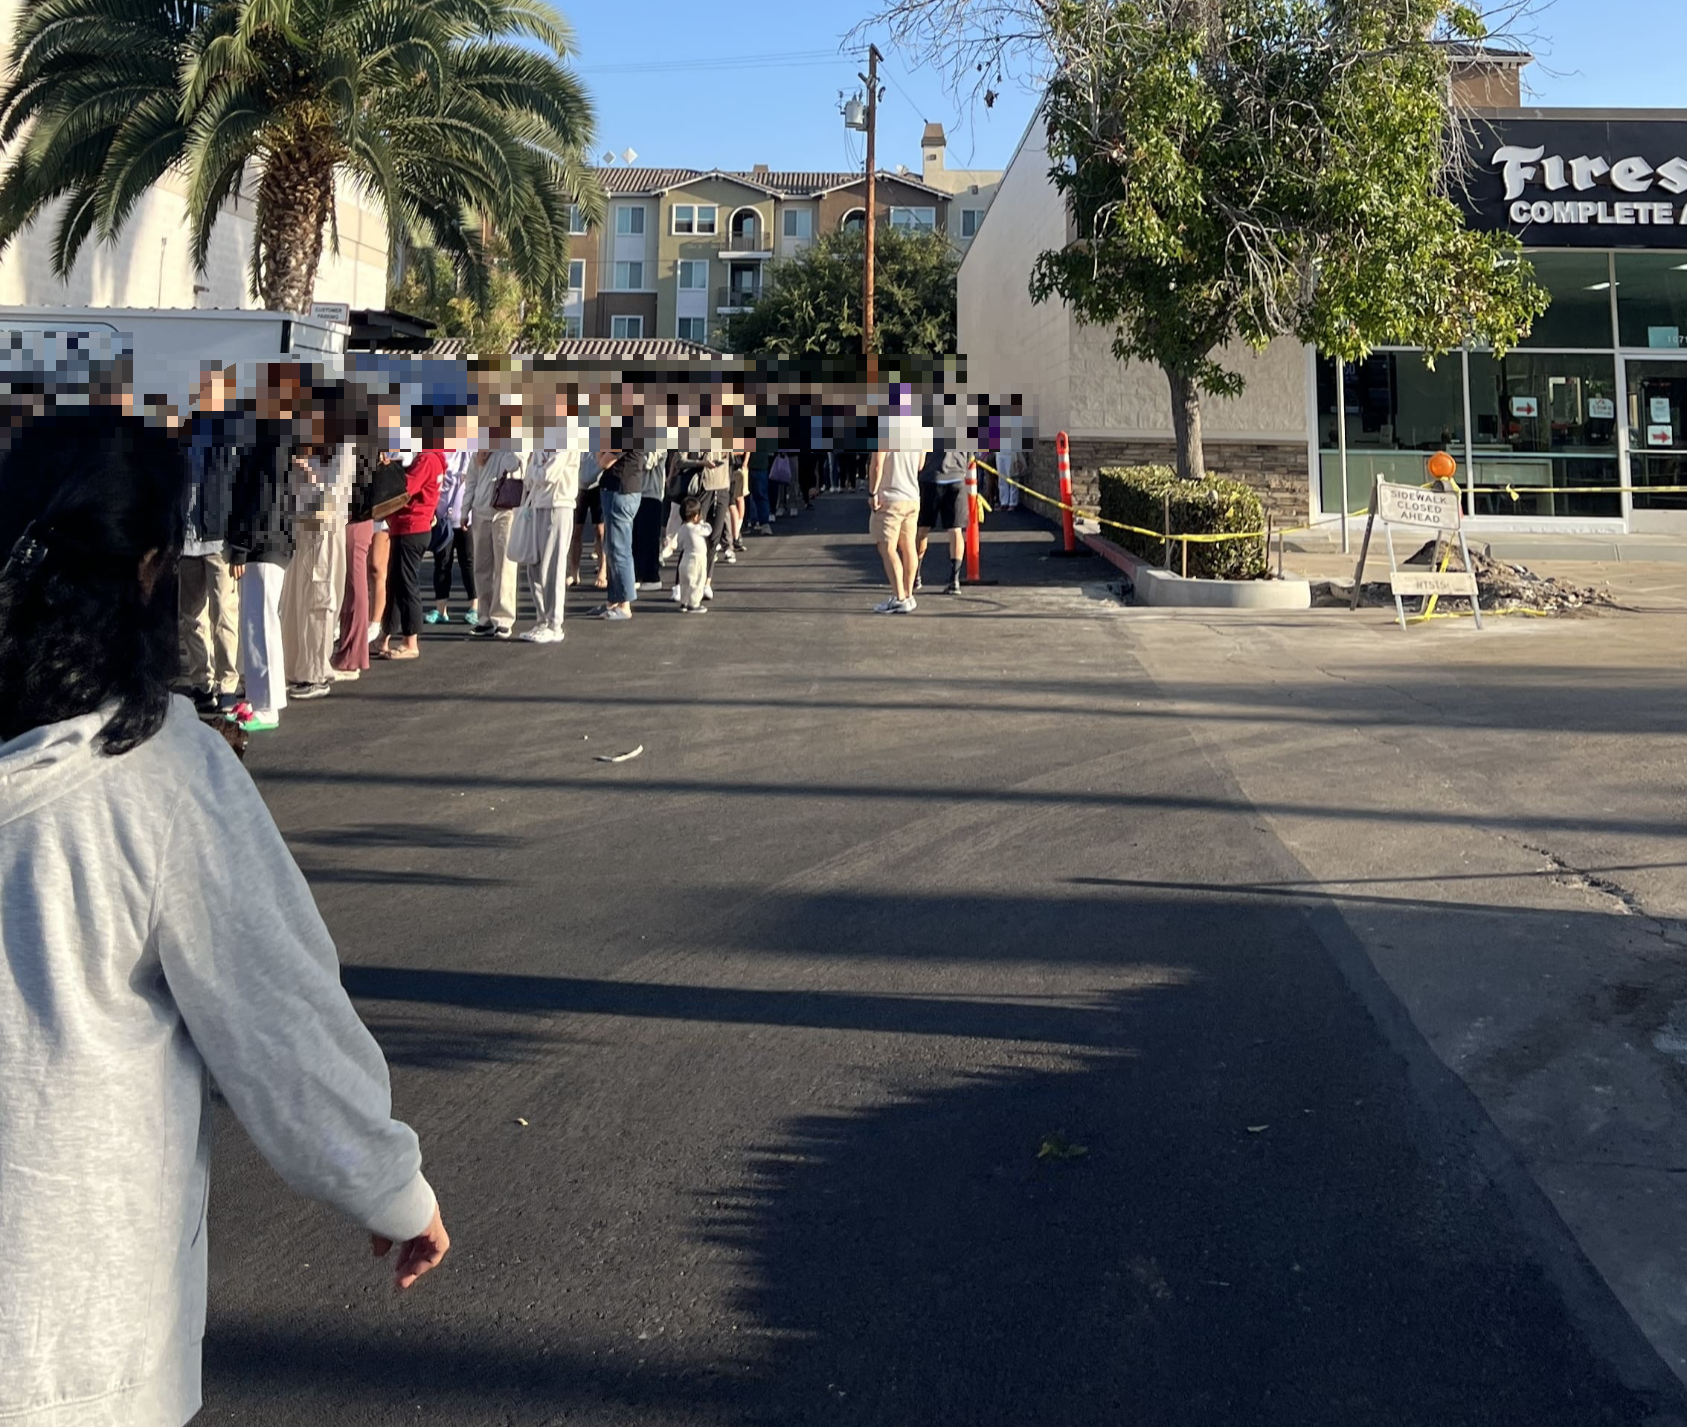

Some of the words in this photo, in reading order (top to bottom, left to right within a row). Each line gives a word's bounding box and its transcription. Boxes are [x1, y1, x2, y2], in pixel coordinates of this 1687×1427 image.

[1491, 144, 1687, 201] Fires
[1510, 200, 1673, 224] COMPLETE
[1391, 490, 1447, 504] SIDEWALK
[1397, 501, 1442, 514] CLOSED
[1400, 511, 1440, 524] AHEAD
